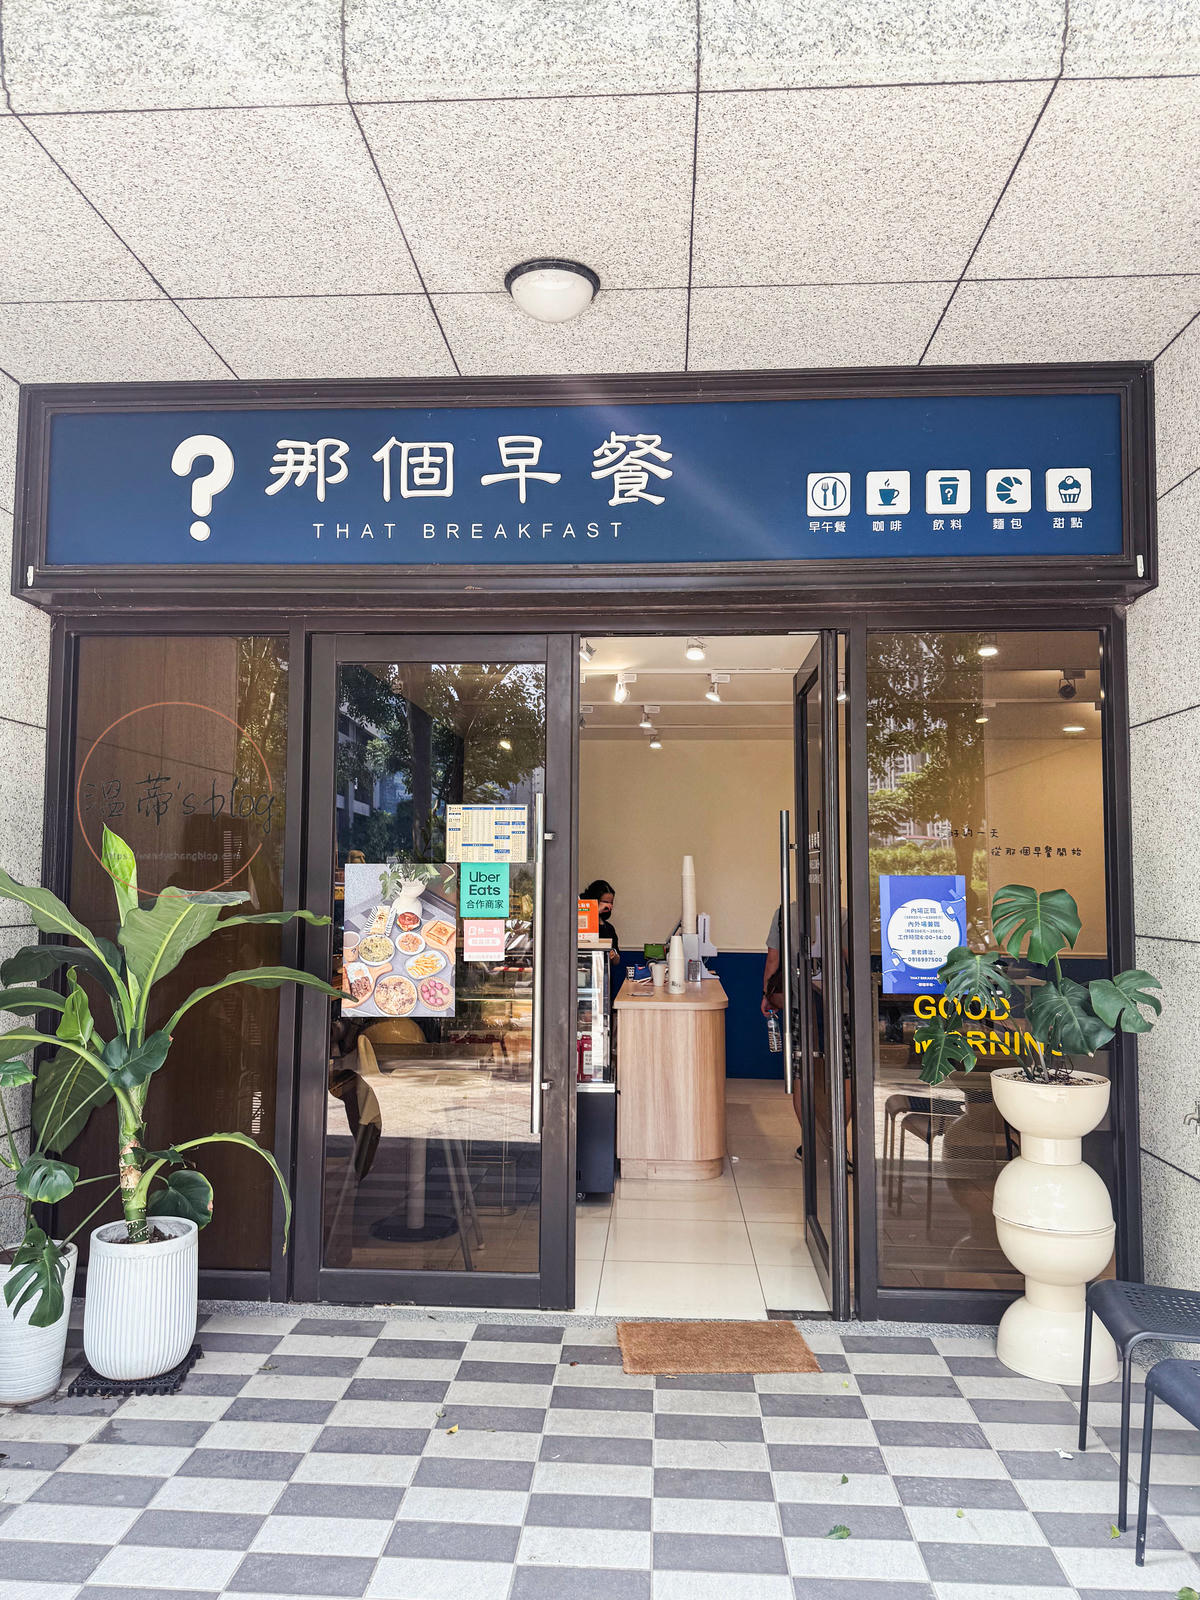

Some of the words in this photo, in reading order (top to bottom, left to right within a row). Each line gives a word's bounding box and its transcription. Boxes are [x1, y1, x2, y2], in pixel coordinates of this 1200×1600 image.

[264, 431, 674, 507] 那個早餐
[808, 521, 848, 533] 早午餐
[872, 520, 902, 532] 咖啡
[932, 519, 963, 531] 飲料
[992, 518, 1023, 530] 麵包
[1052, 517, 1083, 529] 甜點
[312, 523, 397, 539] THAT
[423, 522, 624, 539] BREAKFAST
[938, 825, 1000, 839] 好的一天
[991, 845, 1082, 858] 從那個早餐開始
[469, 871, 501, 883] Uber
[469, 884, 501, 896] Eats
[466, 899, 504, 909] 合作商家
[913, 995, 1011, 1021] GOOD
[914, 1029, 1063, 1056] RNIN
